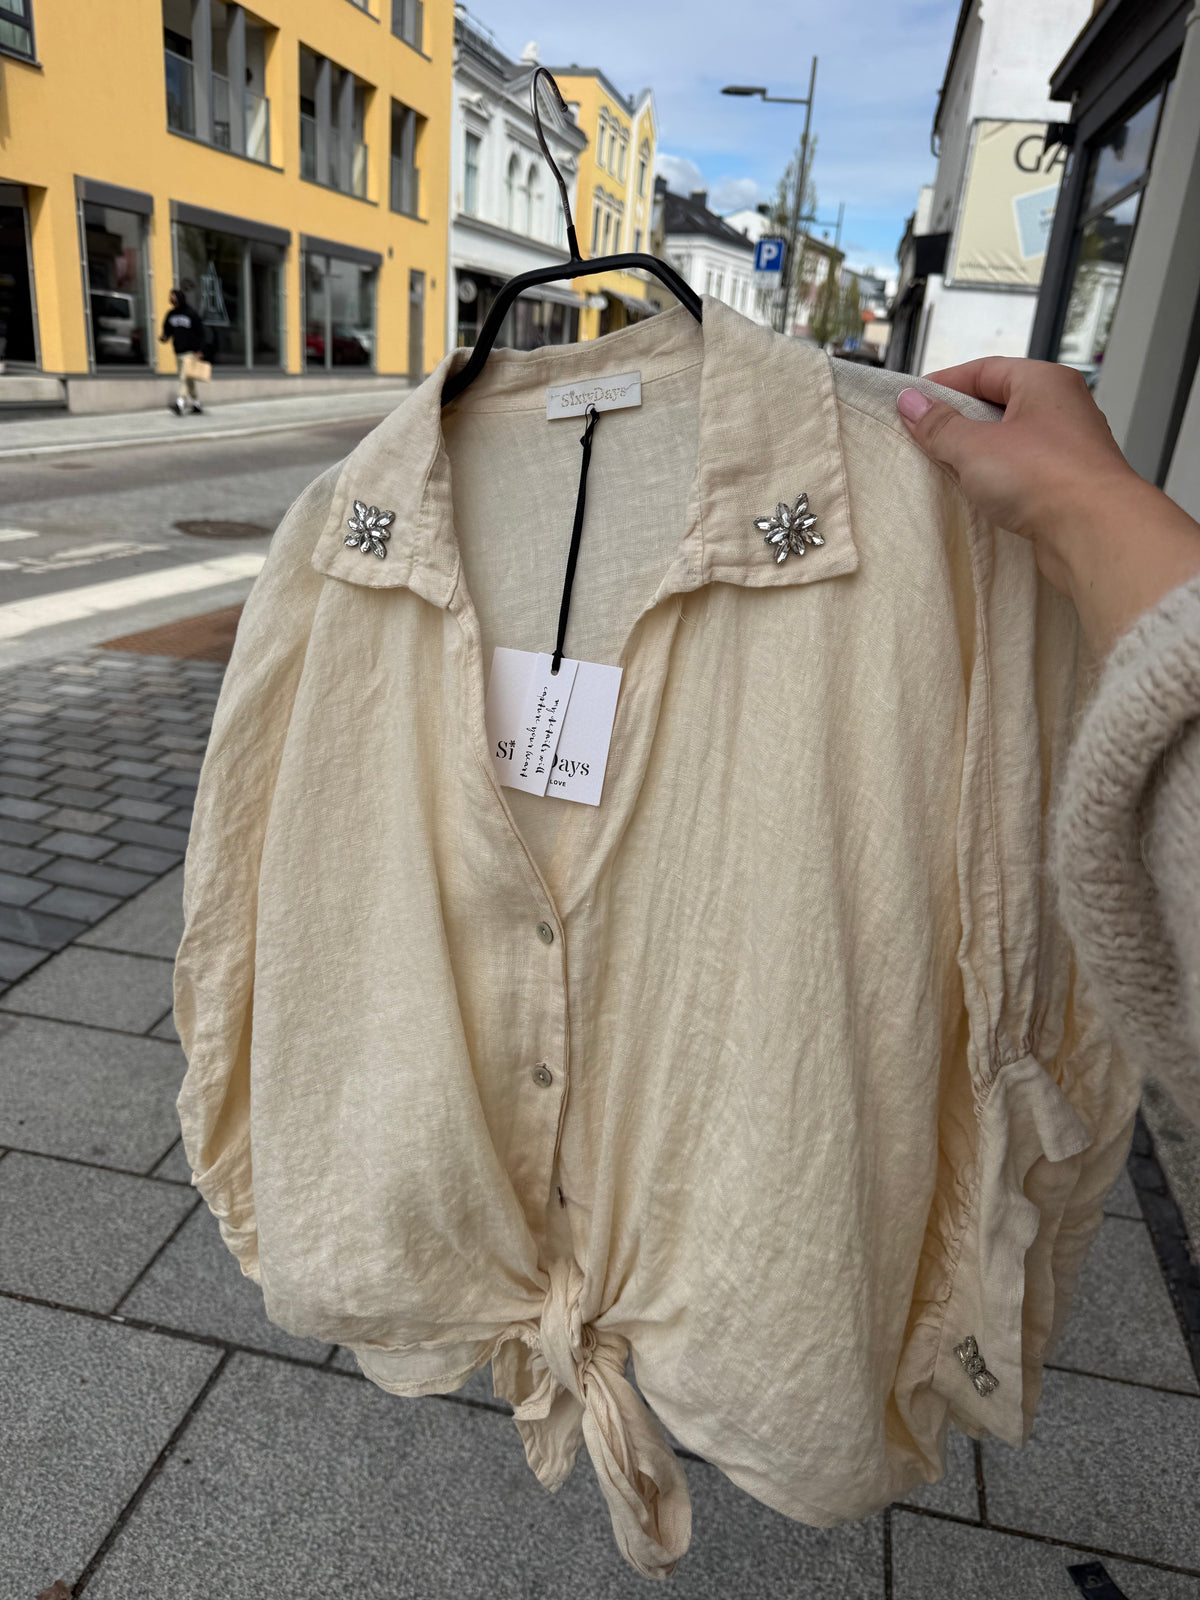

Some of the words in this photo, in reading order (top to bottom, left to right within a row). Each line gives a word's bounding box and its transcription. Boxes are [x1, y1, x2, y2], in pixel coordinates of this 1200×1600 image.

[760, 243, 779, 269] P
[560, 386, 626, 408] SixtyDays
[536, 686, 548, 724] capture
[546, 699, 559, 714] my
[526, 726, 537, 748] your
[541, 715, 557, 752] details
[520, 750, 534, 777] heart
[535, 755, 545, 773] will
